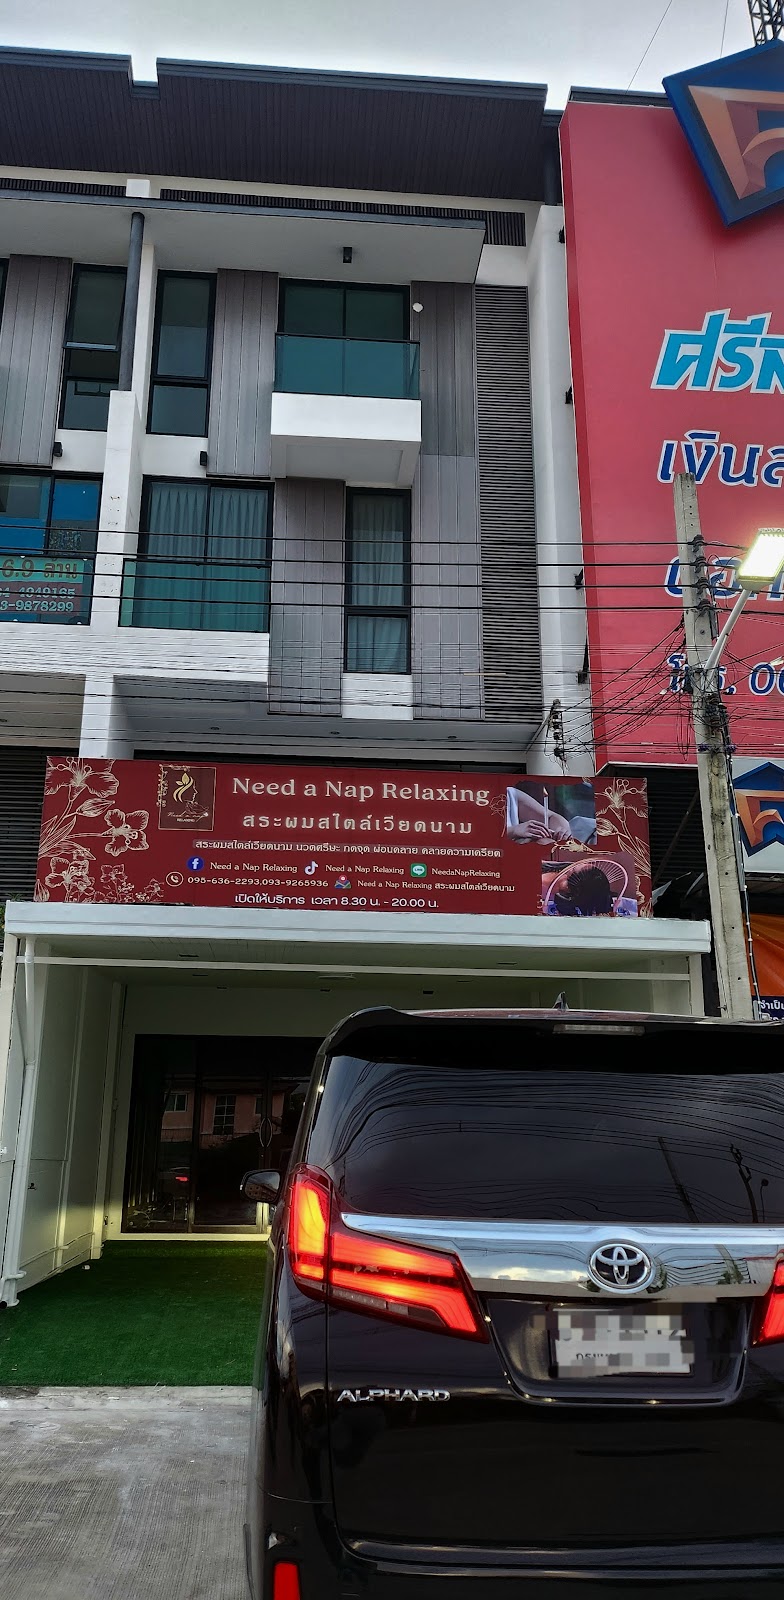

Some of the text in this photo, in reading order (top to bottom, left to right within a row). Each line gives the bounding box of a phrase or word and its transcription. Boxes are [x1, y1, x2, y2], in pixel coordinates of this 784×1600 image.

[232, 777, 490, 807] Need a Nap Relaxing
[242, 812, 472, 834] สระผมสไตล์เวียดนาม
[210, 861, 232, 871] Need
[242, 862, 260, 873] Nap
[262, 863, 298, 874] Relaxing
[325, 864, 345, 873] Need
[355, 865, 371, 875] Nap
[372, 866, 405, 875] Relaxing
[431, 867, 501, 879] NeedaNapRelaxing
[357, 880, 376, 888] Need
[385, 880, 400, 890] Nap
[402, 881, 433, 891] Relaxing
[234, 892, 306, 905] เปิดให้บริการ
[311, 897, 338, 905] เวลา
[340, 896, 367, 906] 8.30
[369, 897, 381, 906] น.
[391, 897, 426, 908] 20.00
[427, 899, 440, 908] น.
[337, 1388, 451, 1402] ALPHARD
